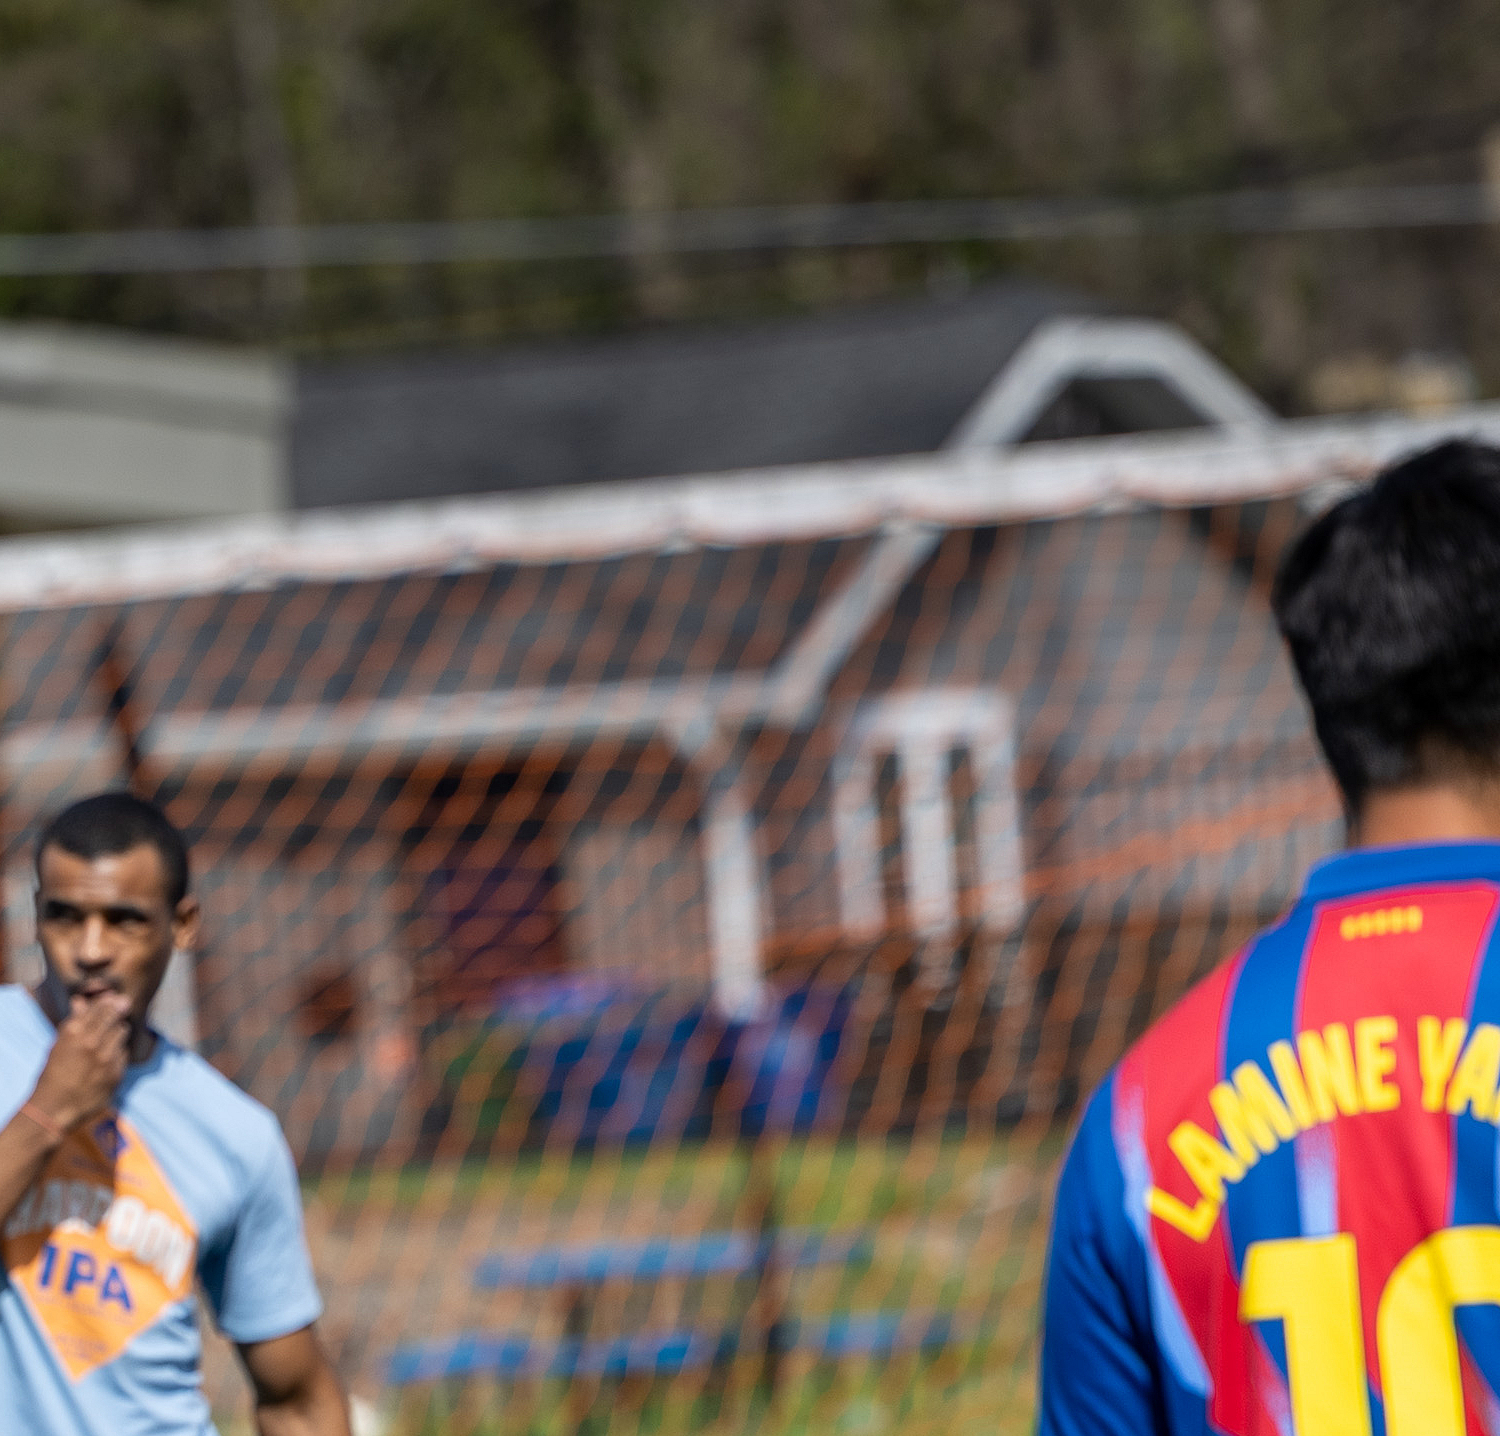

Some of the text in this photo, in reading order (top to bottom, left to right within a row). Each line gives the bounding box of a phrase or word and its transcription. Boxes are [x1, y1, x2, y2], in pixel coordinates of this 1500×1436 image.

[1146, 1014, 1500, 1243] LAMINE YA
[37, 1241, 134, 1313] IPA
